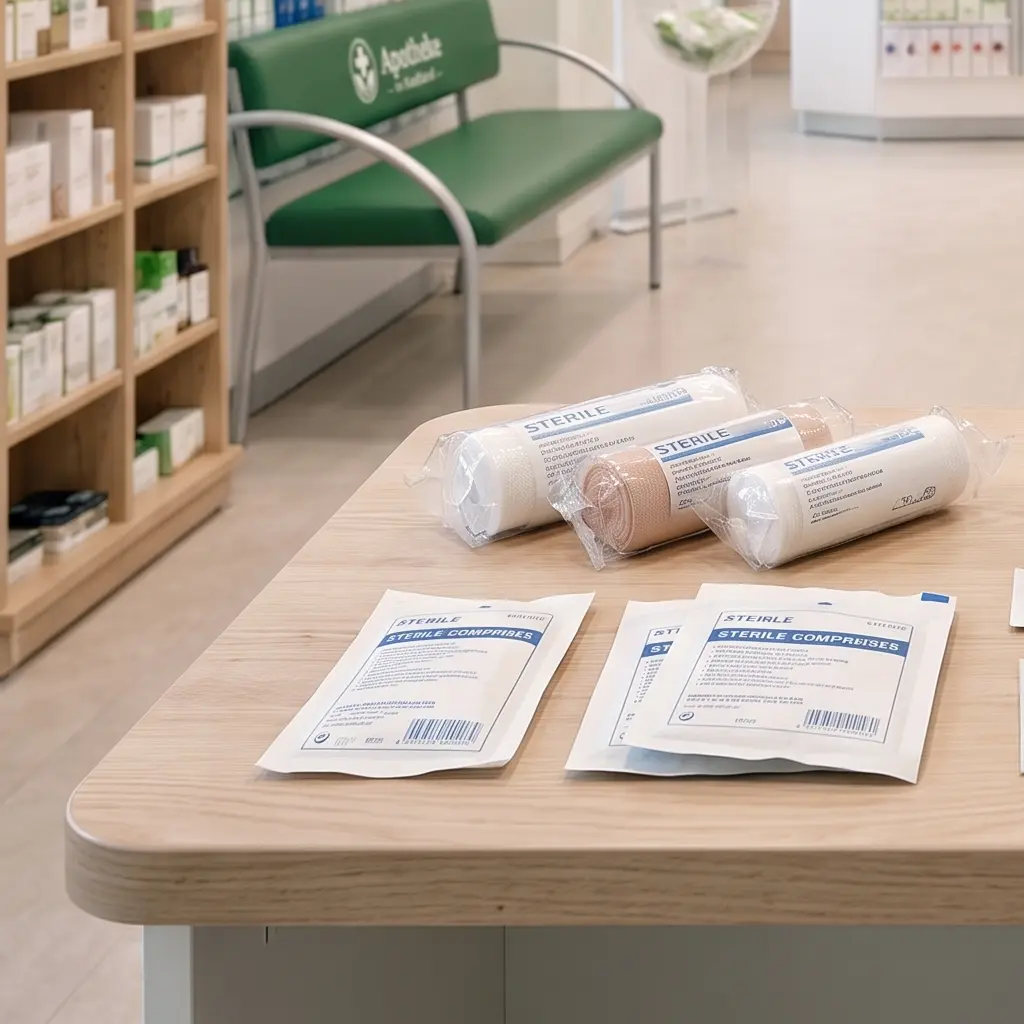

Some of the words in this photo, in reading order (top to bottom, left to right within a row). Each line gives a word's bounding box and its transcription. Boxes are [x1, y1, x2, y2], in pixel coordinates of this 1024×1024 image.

[524, 405, 611, 434] STERILE
[654, 428, 731, 455] STERILE
[717, 629, 788, 640] STERILE
